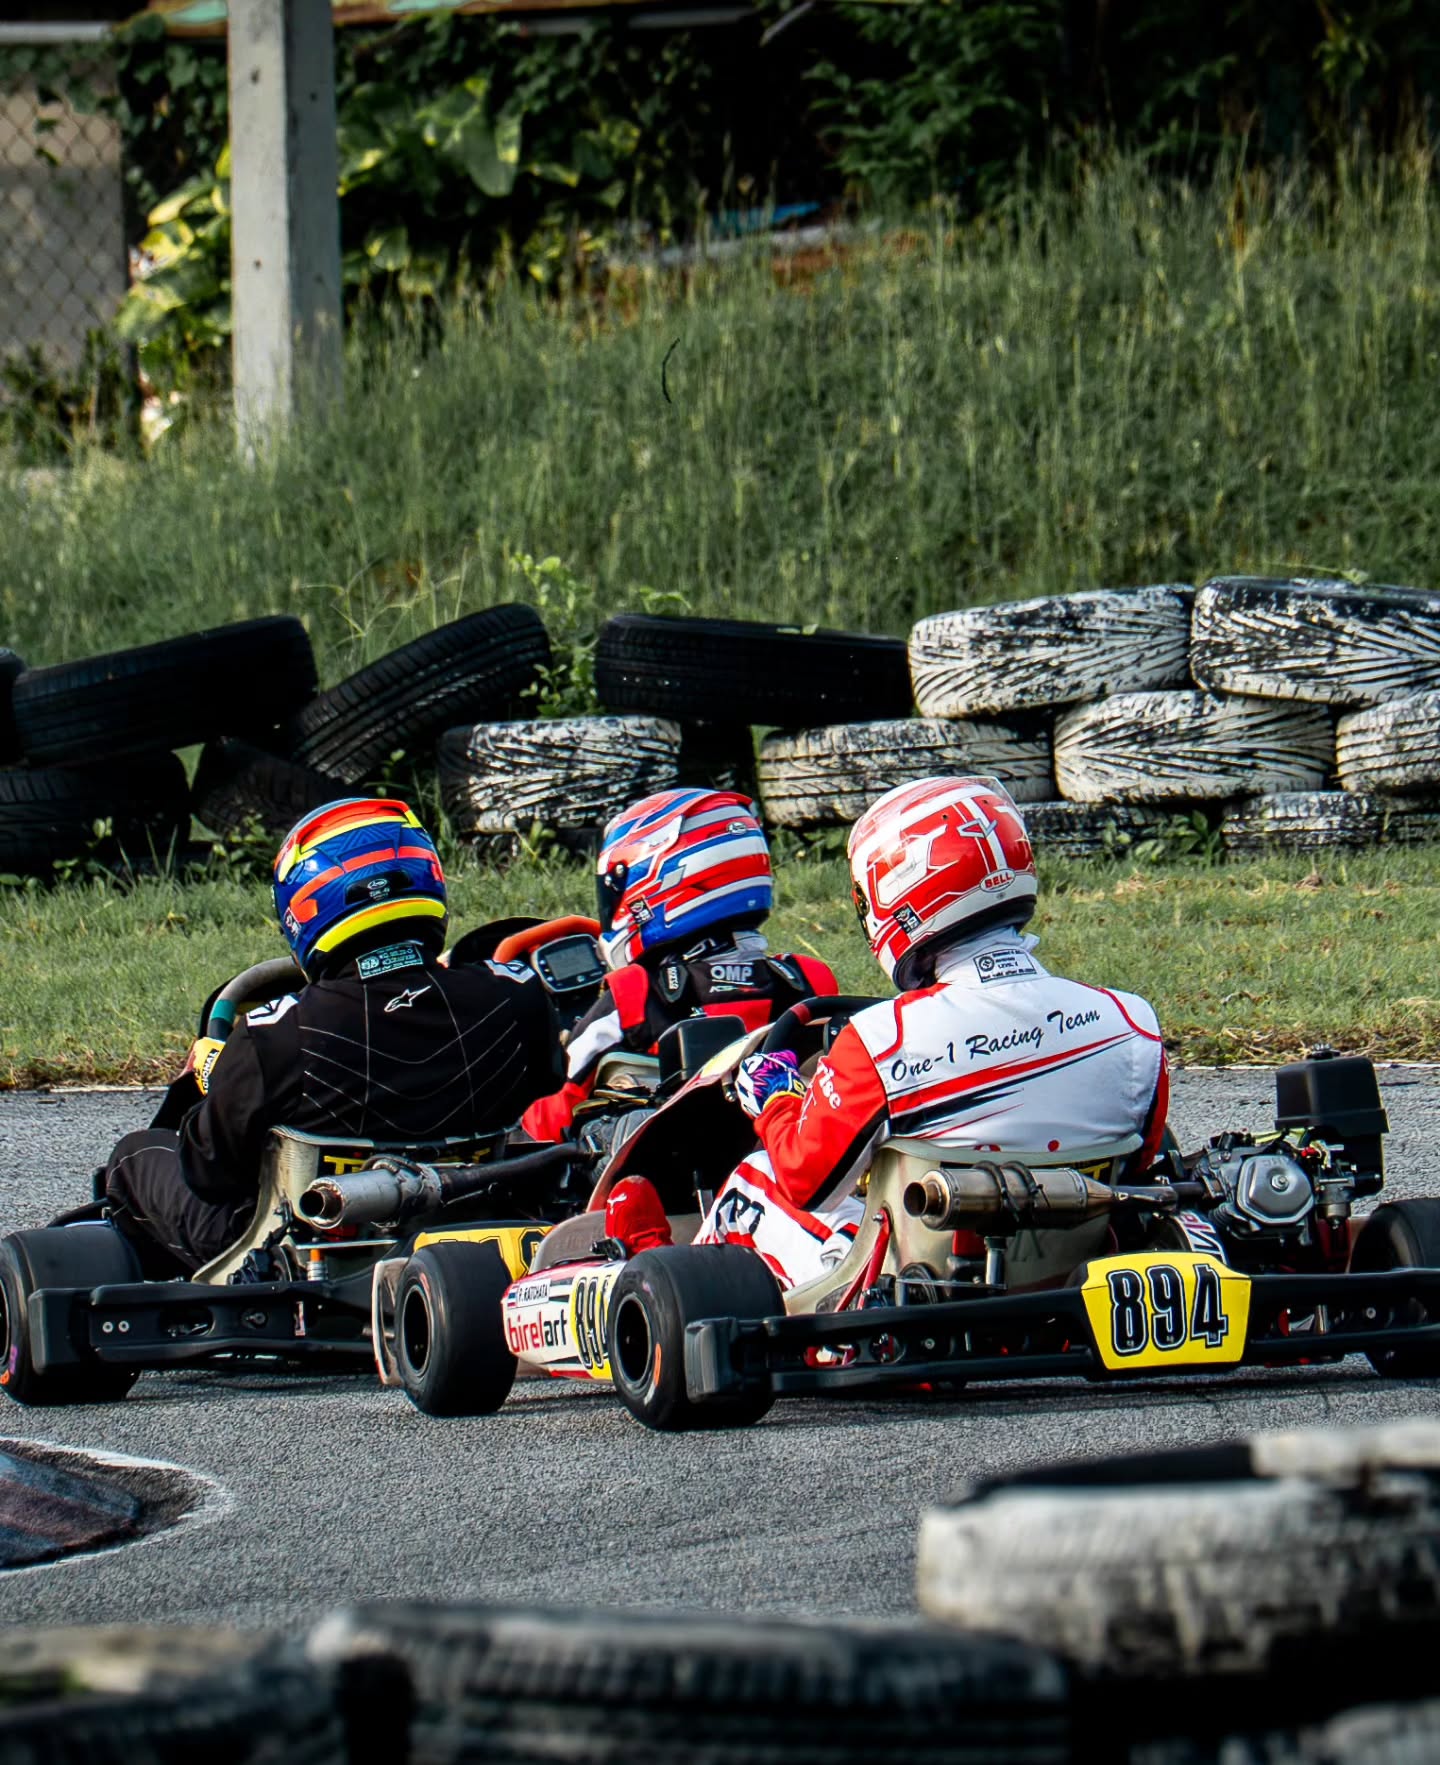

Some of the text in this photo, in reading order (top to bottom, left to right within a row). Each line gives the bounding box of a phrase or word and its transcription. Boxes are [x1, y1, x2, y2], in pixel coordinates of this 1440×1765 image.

[985, 872, 1012, 889] BELL
[709, 964, 753, 983] OMP
[891, 1009, 1100, 1081] One-1 Racing Team
[1106, 1264, 1229, 1357] 894
